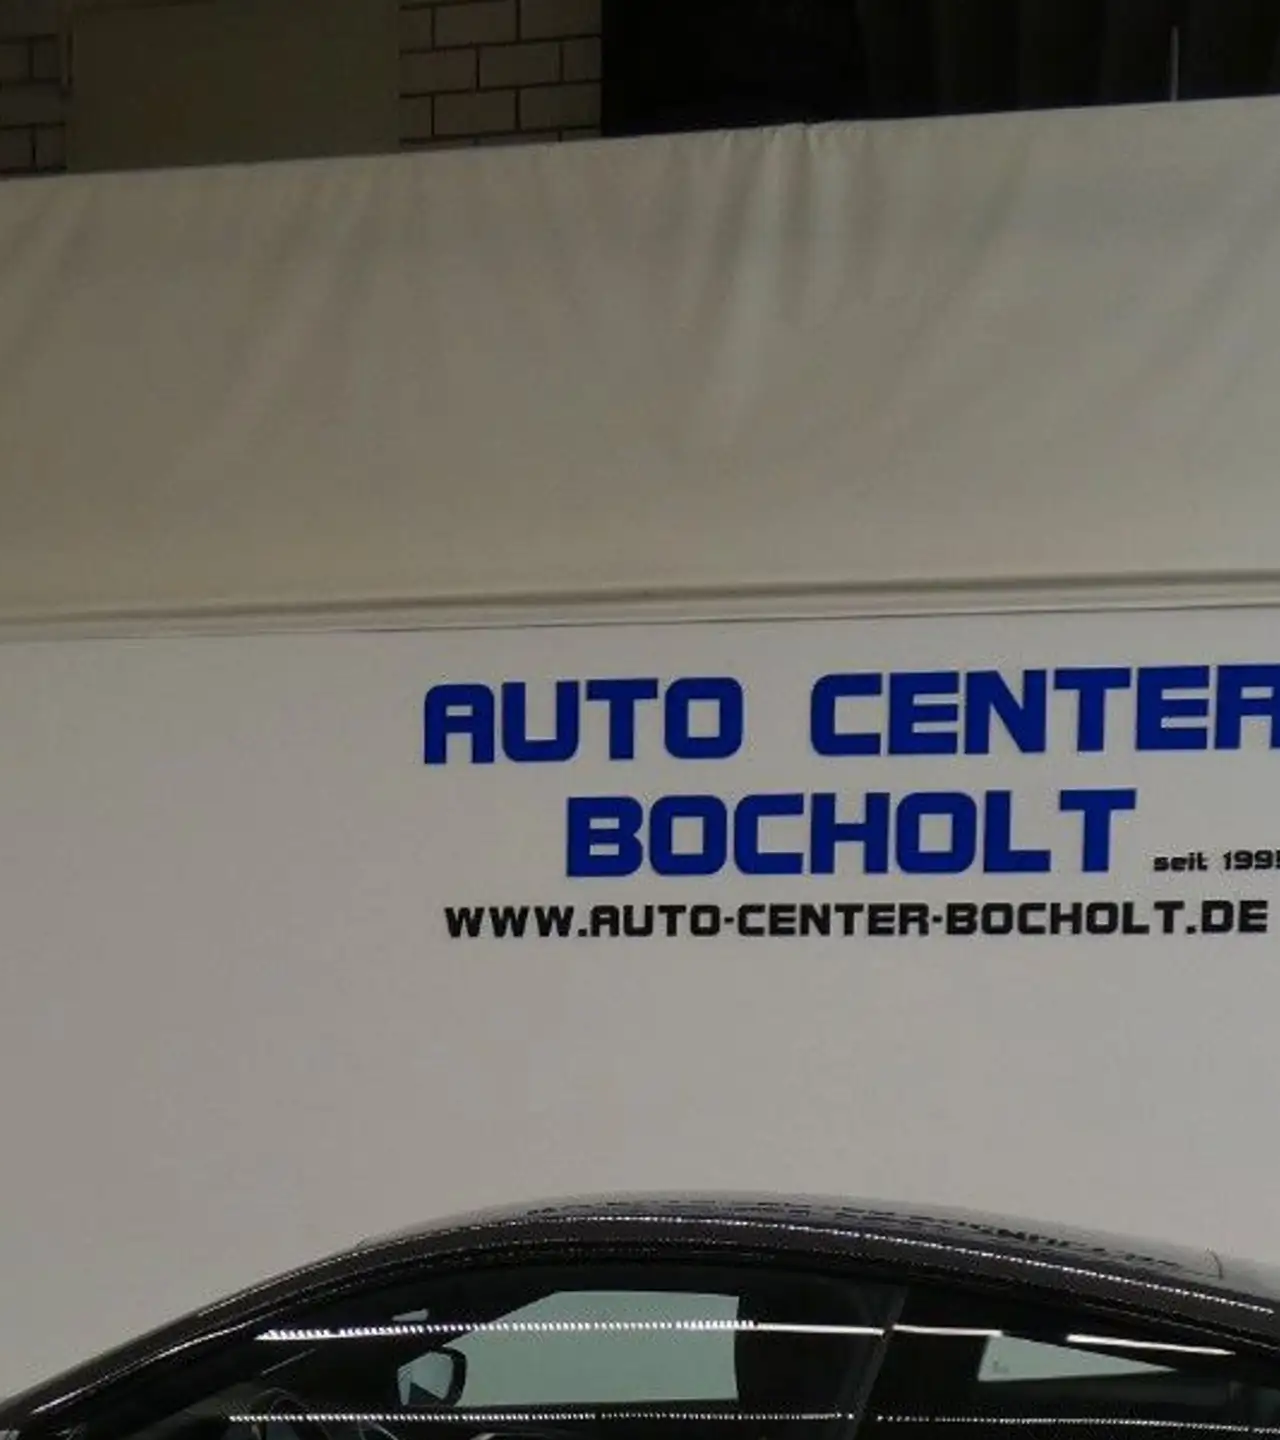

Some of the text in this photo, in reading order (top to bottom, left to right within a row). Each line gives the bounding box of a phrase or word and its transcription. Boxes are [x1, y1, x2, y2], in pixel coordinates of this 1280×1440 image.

[423, 676, 744, 764] AUTO
[566, 788, 1137, 878] BOCHOLT
[1153, 852, 1209, 873] seit
[445, 900, 1269, 939] WWW.AUTO-CENTER-BOCHOLT.DE
